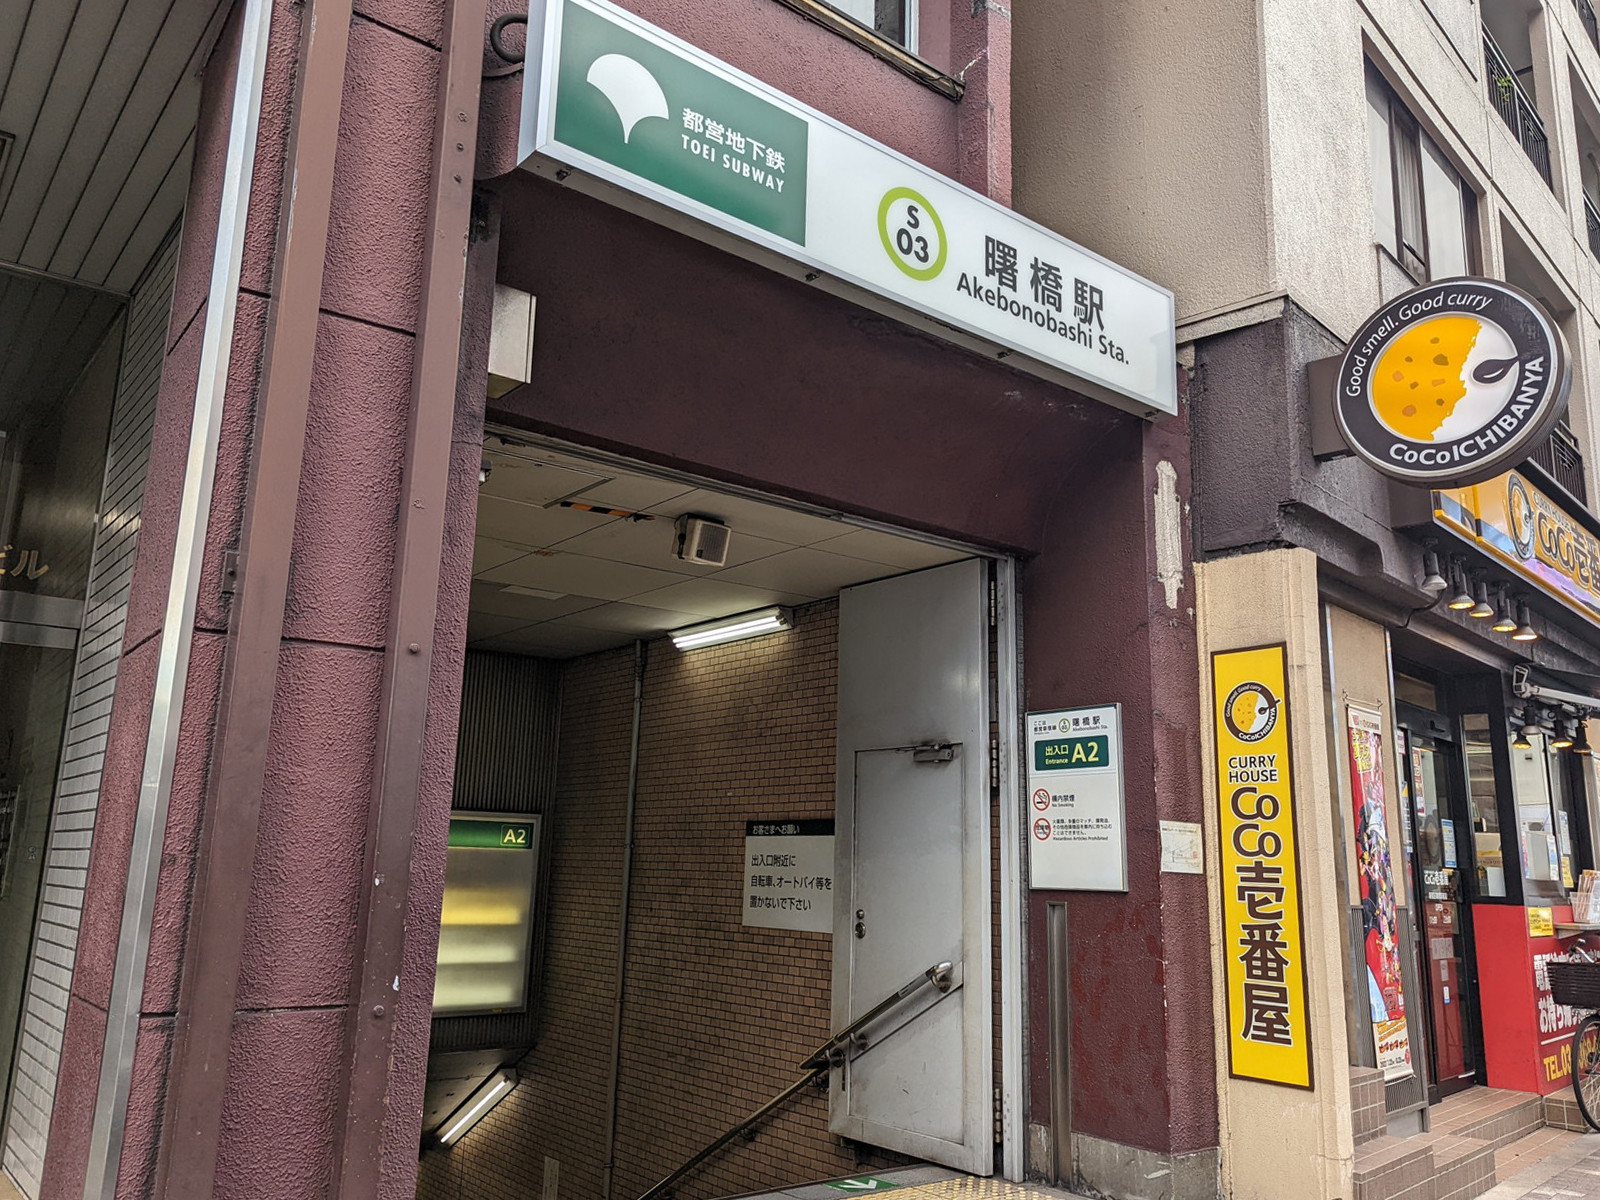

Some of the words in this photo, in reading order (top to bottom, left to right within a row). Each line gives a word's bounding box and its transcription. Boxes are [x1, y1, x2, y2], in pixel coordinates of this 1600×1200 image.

[682, 108, 785, 173] 都営地下鉄
[681, 134, 715, 162] TOEI
[722, 154, 784, 193] SUBWAY
[907, 205, 920, 229] S
[896, 228, 929, 263] 03
[985, 235, 1104, 331] 曙橋駅
[956, 272, 1093, 350] Akebonobashi
[1098, 335, 1130, 365] Sta.
[1346, 355, 1367, 397] Good
[1363, 315, 1399, 355] smell.
[1399, 291, 1444, 322] Good
[1447, 292, 1493, 311] curry
[1045, 744, 1069, 756] 出入口
[1071, 741, 1099, 763] A2
[1229, 755, 1276, 769] CURRY
[1229, 769, 1277, 783] HOUSE
[503, 829, 526, 844] A2
[752, 854, 796, 867] 出入口附近に
[750, 875, 832, 890] 自転車、オートバイ等を
[749, 895, 812, 911] 置かないで下さい
